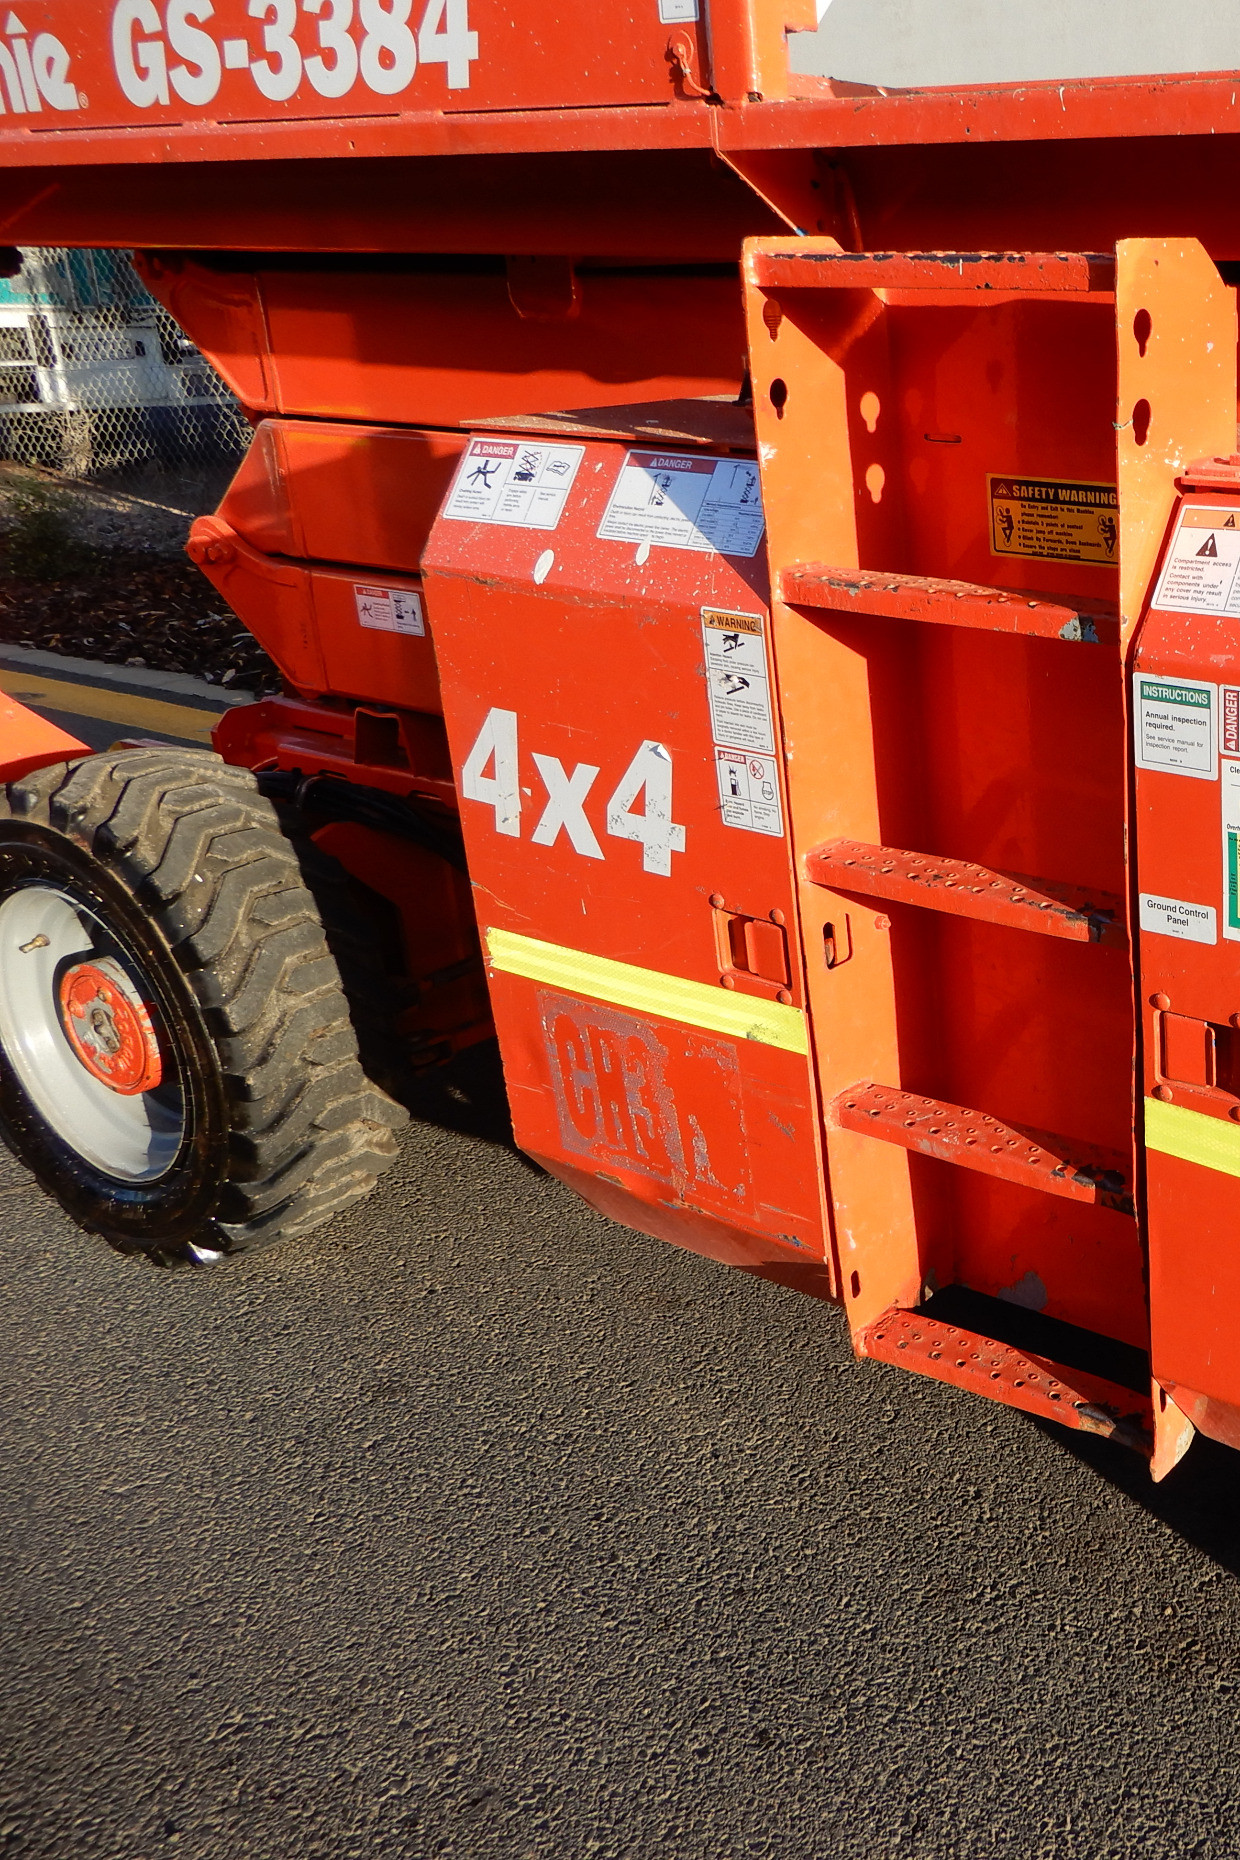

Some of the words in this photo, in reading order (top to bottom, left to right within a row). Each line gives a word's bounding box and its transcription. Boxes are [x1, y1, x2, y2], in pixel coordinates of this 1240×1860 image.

[112, 0, 478, 107] GS-3384
[482, 443, 514, 456] DANGER
[657, 458, 693, 469] DANGER
[1012, 485, 1055, 500] SAFETY
[1058, 488, 1117, 505] WARNING
[1174, 557, 1211, 568] Compartment
[1178, 564, 1206, 573] restricted.
[1169, 572, 1191, 580] Contact
[1192, 573, 1205, 581] with
[1166, 580, 1201, 589] components
[1170, 593, 1190, 601] serious
[1143, 685, 1208, 705] INSTRUCTIONS
[1146, 711, 1169, 721] Annual
[1172, 715, 1207, 729] inspection
[1226, 692, 1237, 740] DANGER
[1146, 721, 1175, 733] required.
[1146, 733, 1156, 741] See
[1158, 735, 1175, 744] service
[1177, 738, 1195, 747] manual
[1172, 745, 1188, 754] report.
[461, 707, 686, 877] 4x4
[1147, 900, 1176, 913] Ground
[1179, 906, 1208, 919] Control
[1167, 915, 1189, 926] Panel
